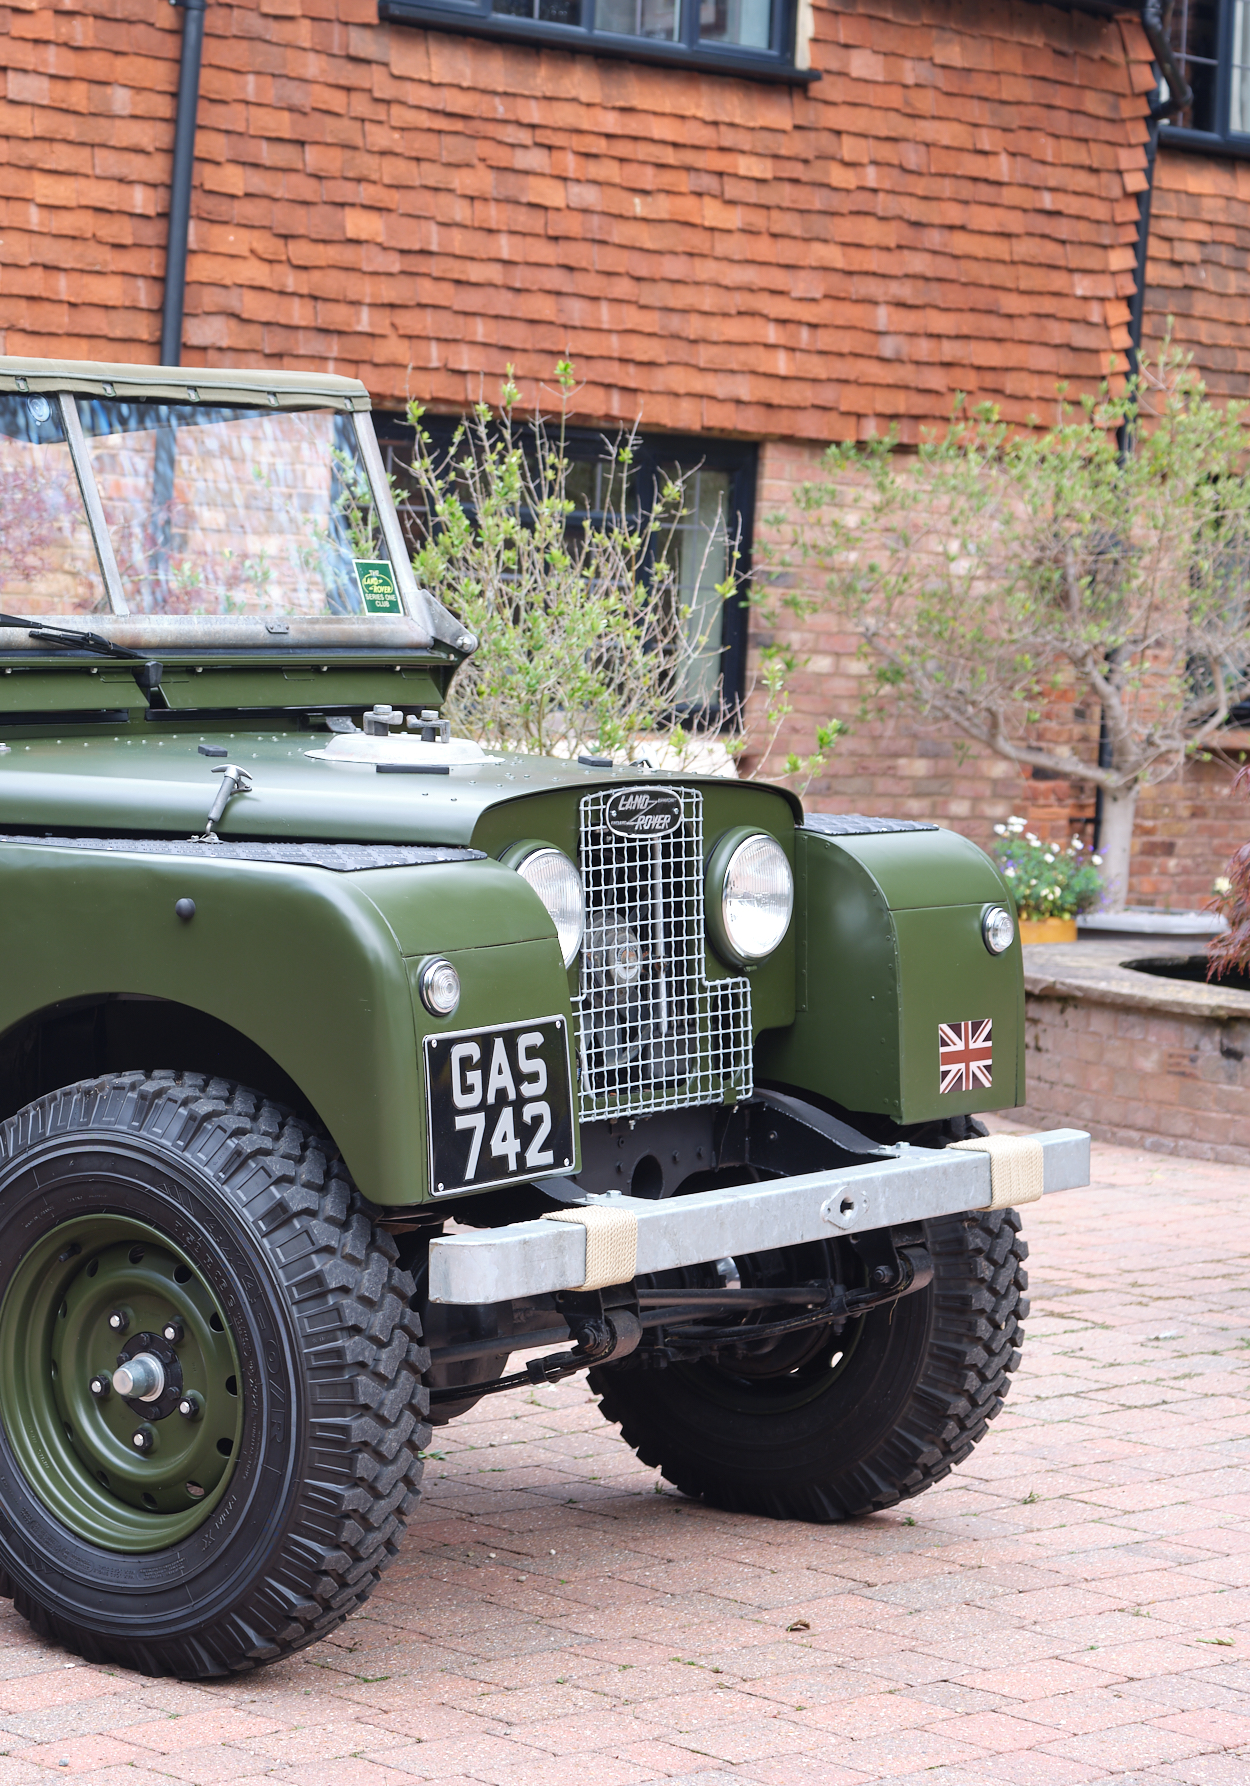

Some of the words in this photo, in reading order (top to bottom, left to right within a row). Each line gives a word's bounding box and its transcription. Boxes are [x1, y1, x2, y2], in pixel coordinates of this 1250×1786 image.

[618, 794, 650, 811] LAND
[635, 814, 671, 831] ROVER
[450, 1031, 548, 1110] GAS
[454, 1100, 555, 1182] 742
